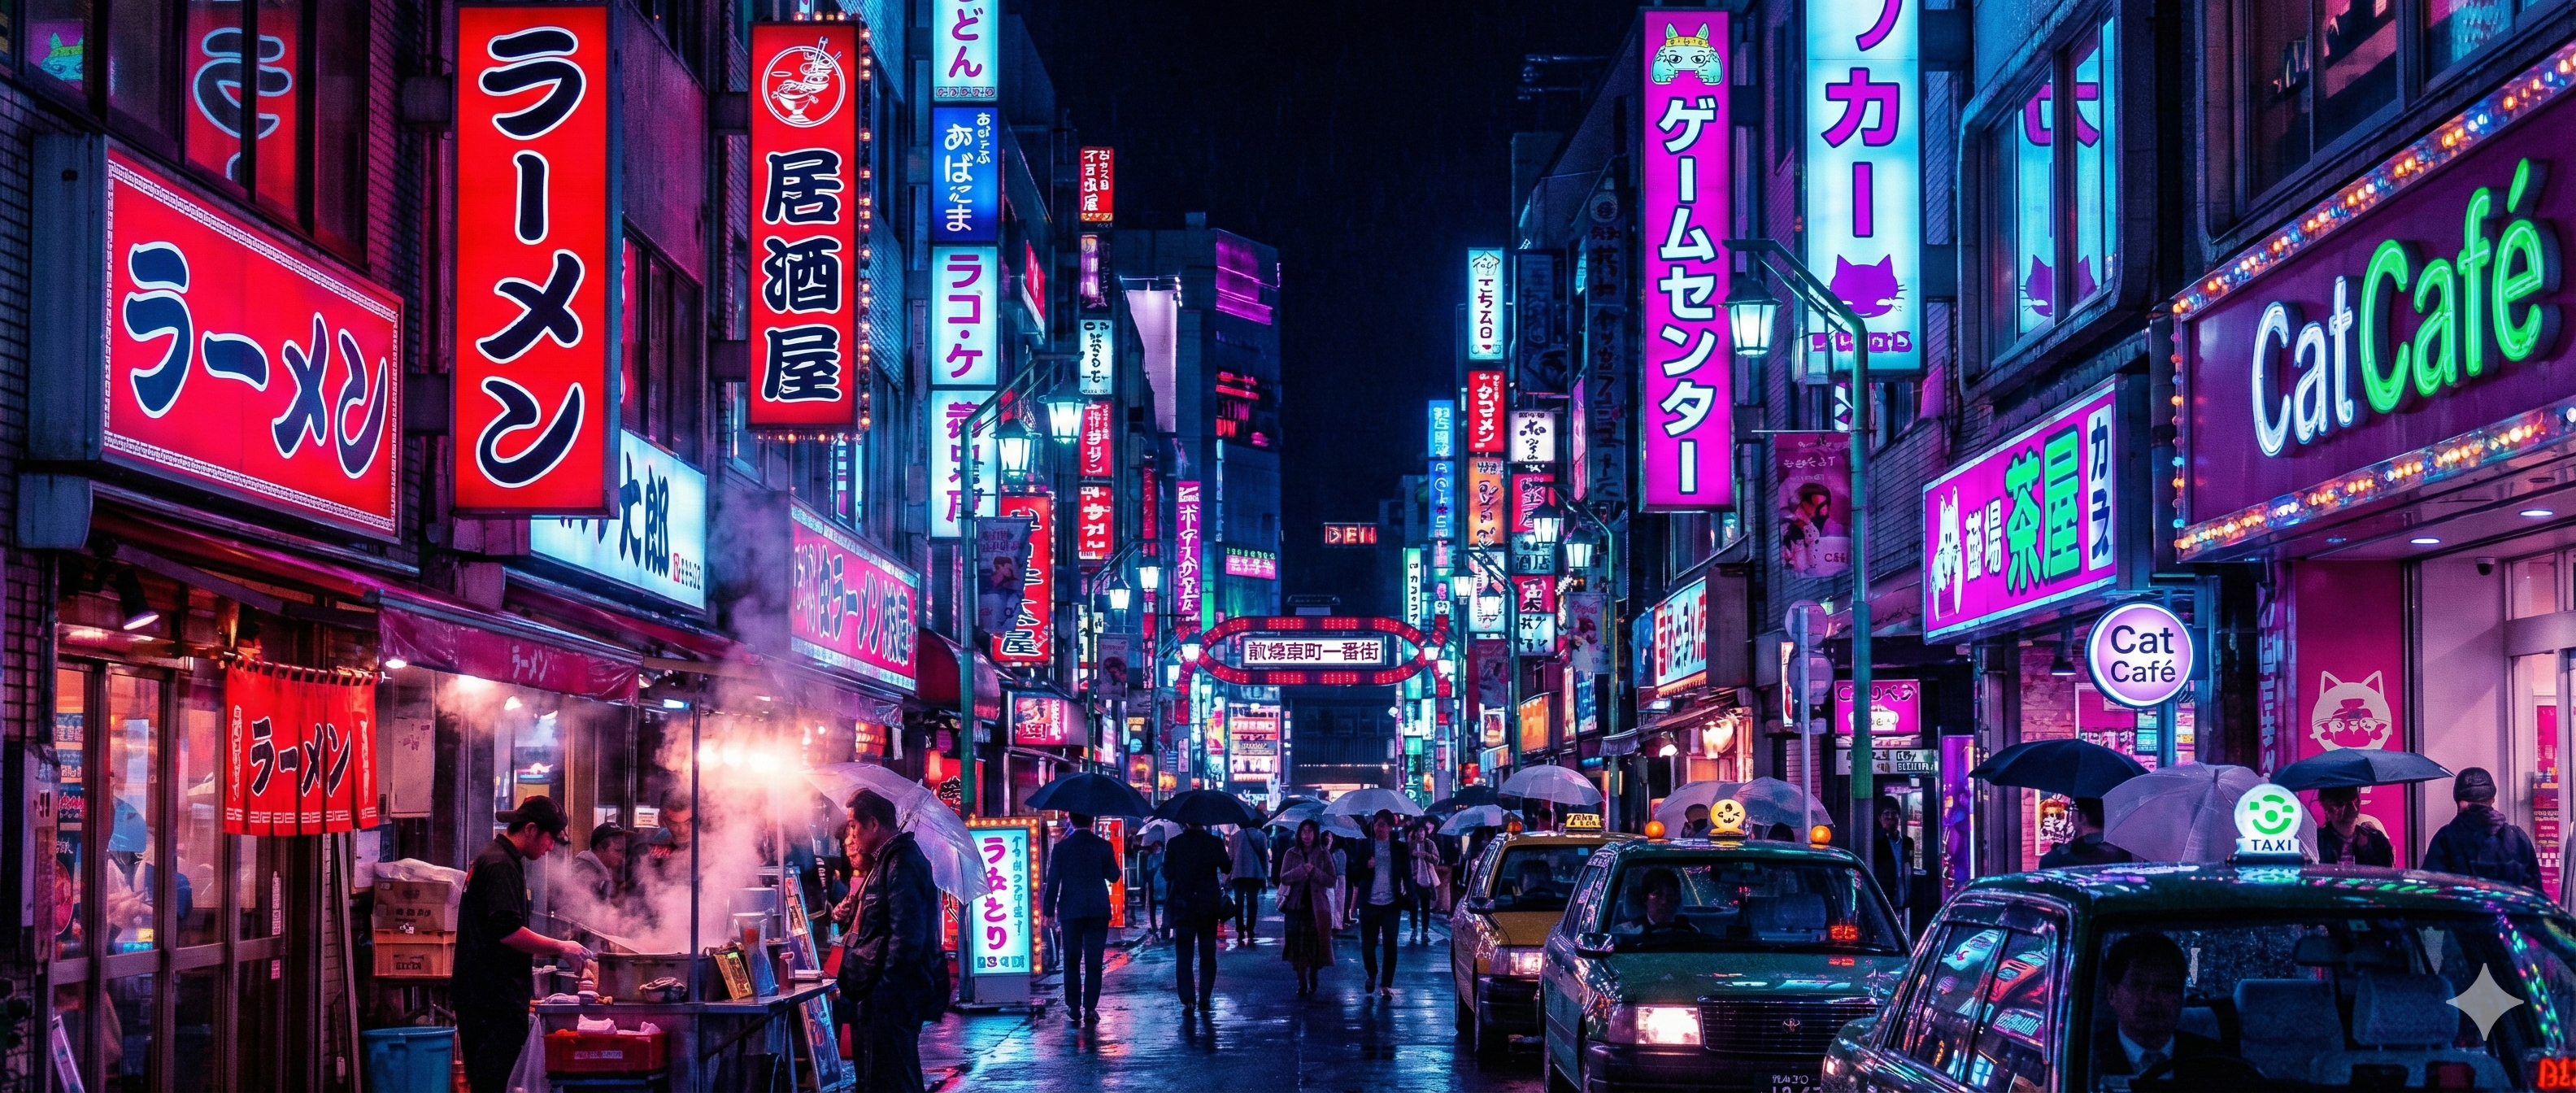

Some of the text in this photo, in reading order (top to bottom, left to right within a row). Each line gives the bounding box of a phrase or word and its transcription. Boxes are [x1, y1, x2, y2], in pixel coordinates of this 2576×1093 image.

[948, 0, 984, 78] どん
[476, 26, 587, 488] ラーメン
[763, 147, 842, 403] 居酒屋
[1656, 96, 1717, 494] ゲームセンター
[2252, 158, 2545, 459] Cat Café
[123, 242, 387, 480] ラーメン
[511, 645, 547, 681] ラーメン
[2110, 625, 2174, 654] Cat
[2110, 660, 2176, 683] Café
[250, 716, 350, 798] ラーメン
[2251, 839, 2291, 851] TAXI
